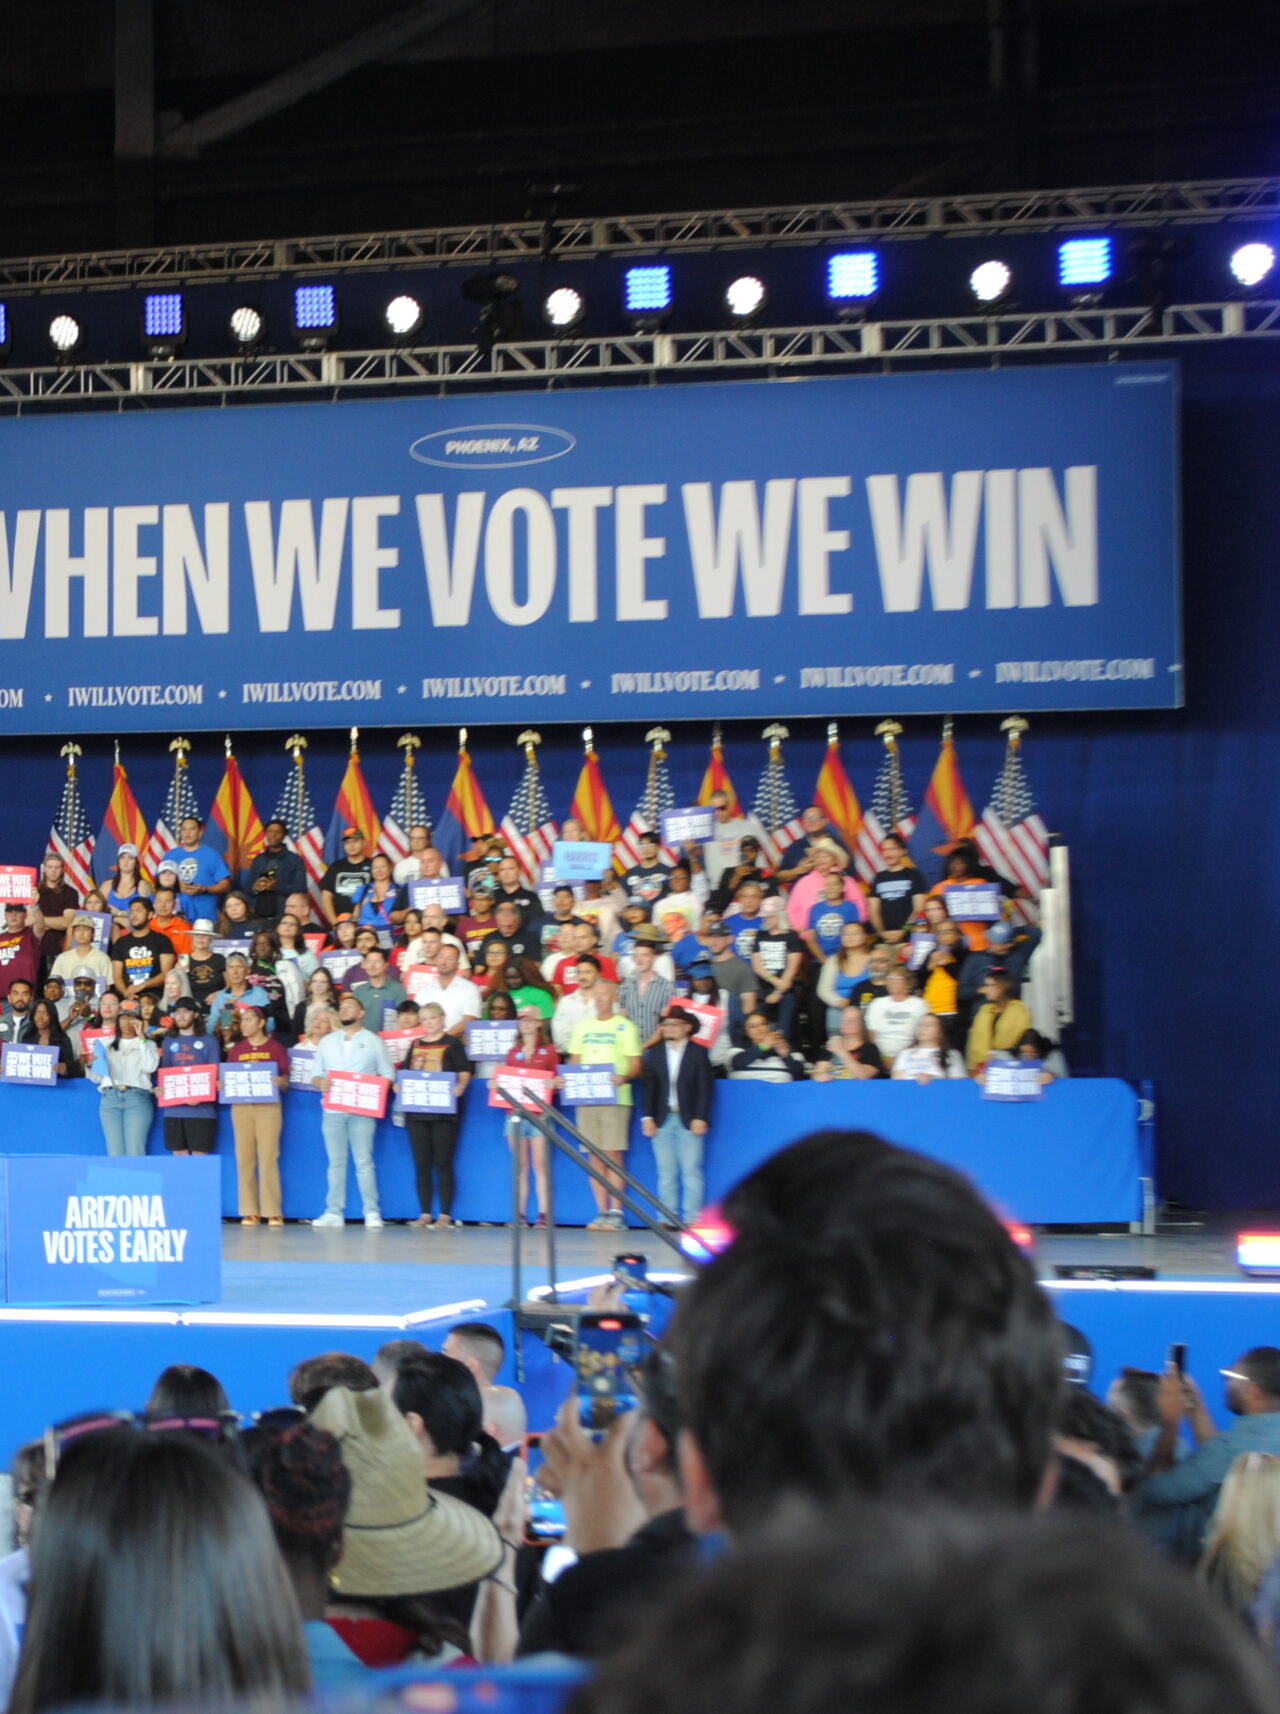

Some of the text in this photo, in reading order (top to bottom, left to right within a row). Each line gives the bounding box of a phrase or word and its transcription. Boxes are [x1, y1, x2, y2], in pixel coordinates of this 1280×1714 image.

[445, 436, 541, 456] PHOENIX, AZ
[245, 495, 400, 633] WE
[415, 483, 668, 627] VOTE
[681, 475, 853, 620] WE
[865, 465, 1099, 613] WIN
[67, 684, 203, 709] IWILLVOTE.COM
[242, 679, 382, 705] IWILLVOTE.COM
[422, 673, 566, 700] IWILLVOTE.COM
[610, 668, 760, 695] IWILLVOTE.COM
[800, 662, 954, 689] IWILLVOTE.COM
[995, 656, 1155, 684] IWILLVOTE.COM
[11, 874, 32, 886] VOTE
[11, 886, 32, 898] WIN
[17, 1052, 53, 1066] WE VOTE
[17, 1065, 51, 1079] WE WIN
[65, 1195, 166, 1229] ARIZONA
[43, 1229, 188, 1264] VOTES EARLY
